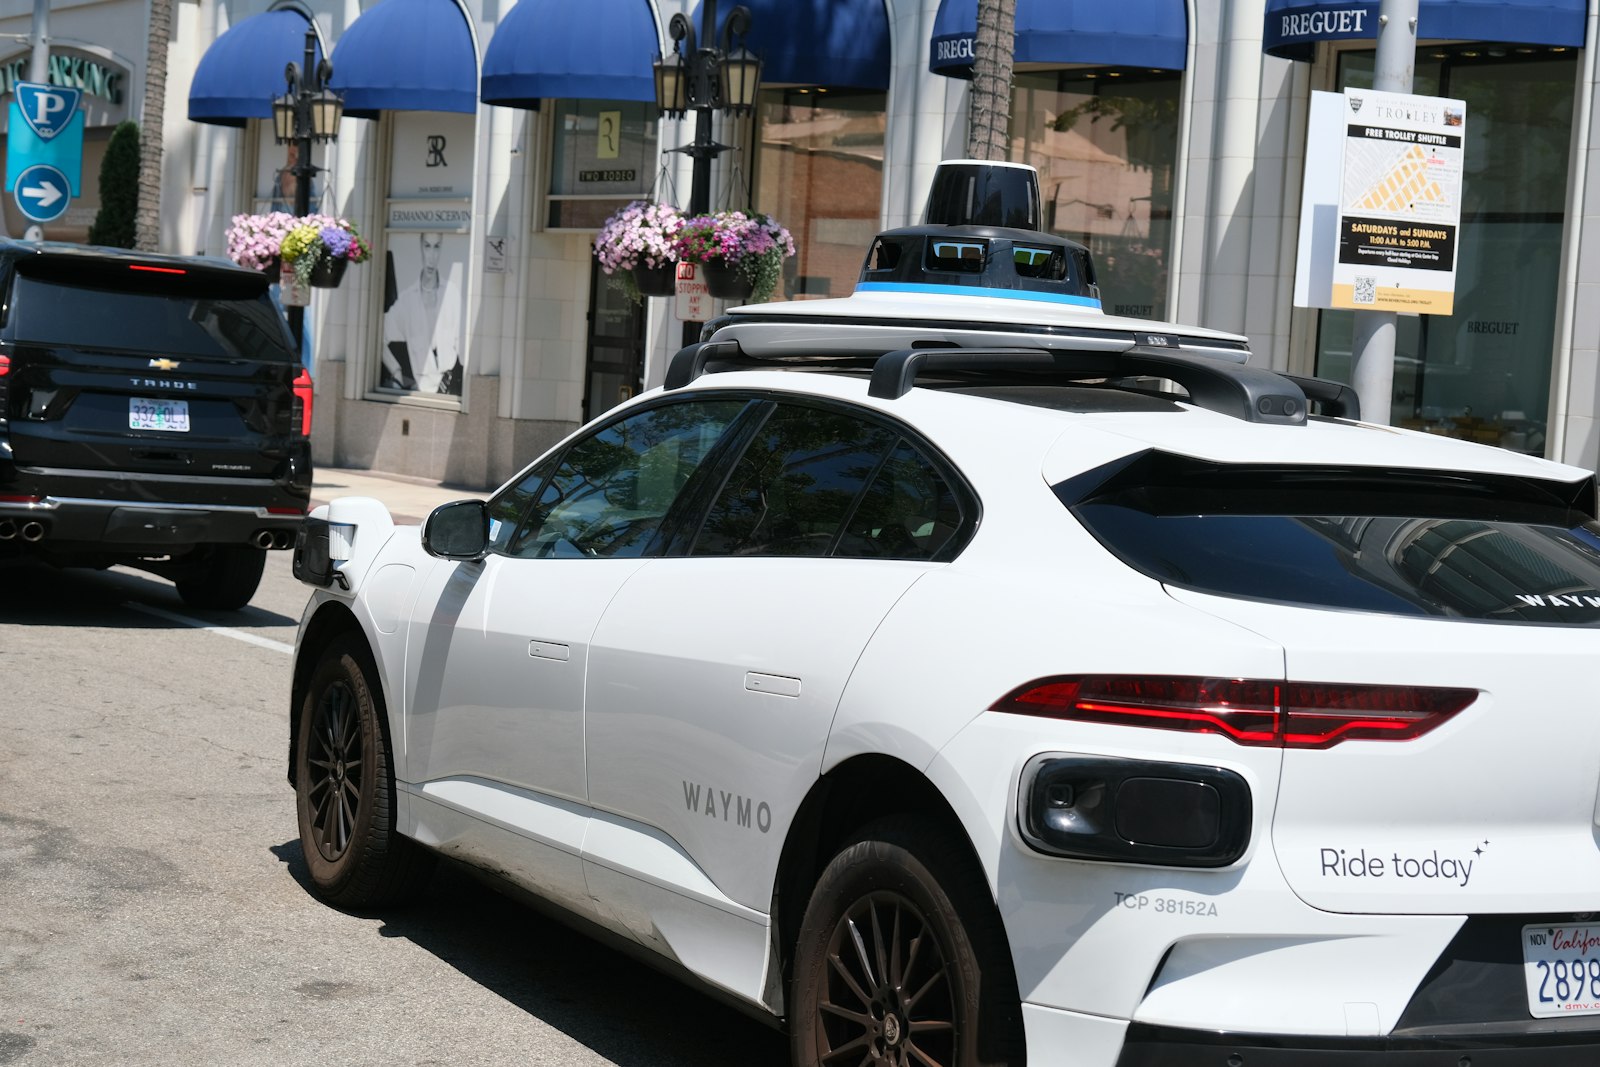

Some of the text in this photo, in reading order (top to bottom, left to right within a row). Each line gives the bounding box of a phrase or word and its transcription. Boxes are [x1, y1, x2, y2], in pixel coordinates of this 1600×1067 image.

[1281, 9, 1367, 37] BREGUET
[937, 38, 976, 60] BREGU
[47, 54, 123, 105] ARKING
[32, 92, 65, 125] P
[1365, 127, 1447, 145] FREE TROLLEY SHUTTLE
[392, 210, 472, 221] ERMANNO SCERVIN
[1351, 223, 1447, 240] SATURDAYS and SUNDAYS
[1407, 239, 1419, 248] 5:00
[679, 264, 694, 279] NO
[679, 282, 708, 294] STOPPIN
[689, 296, 701, 304] ANY
[1114, 304, 1154, 316] BREGUET
[1467, 321, 1519, 335] BREGUET
[130, 378, 197, 390] TAHOE
[133, 405, 156, 423] 332
[682, 780, 772, 834] WAYMO
[1320, 848, 1473, 888] Ride today
[1114, 891, 1218, 917] TCP 38152A
[1530, 934, 1547, 946] NOV
[1536, 958, 1600, 1003] 2898
